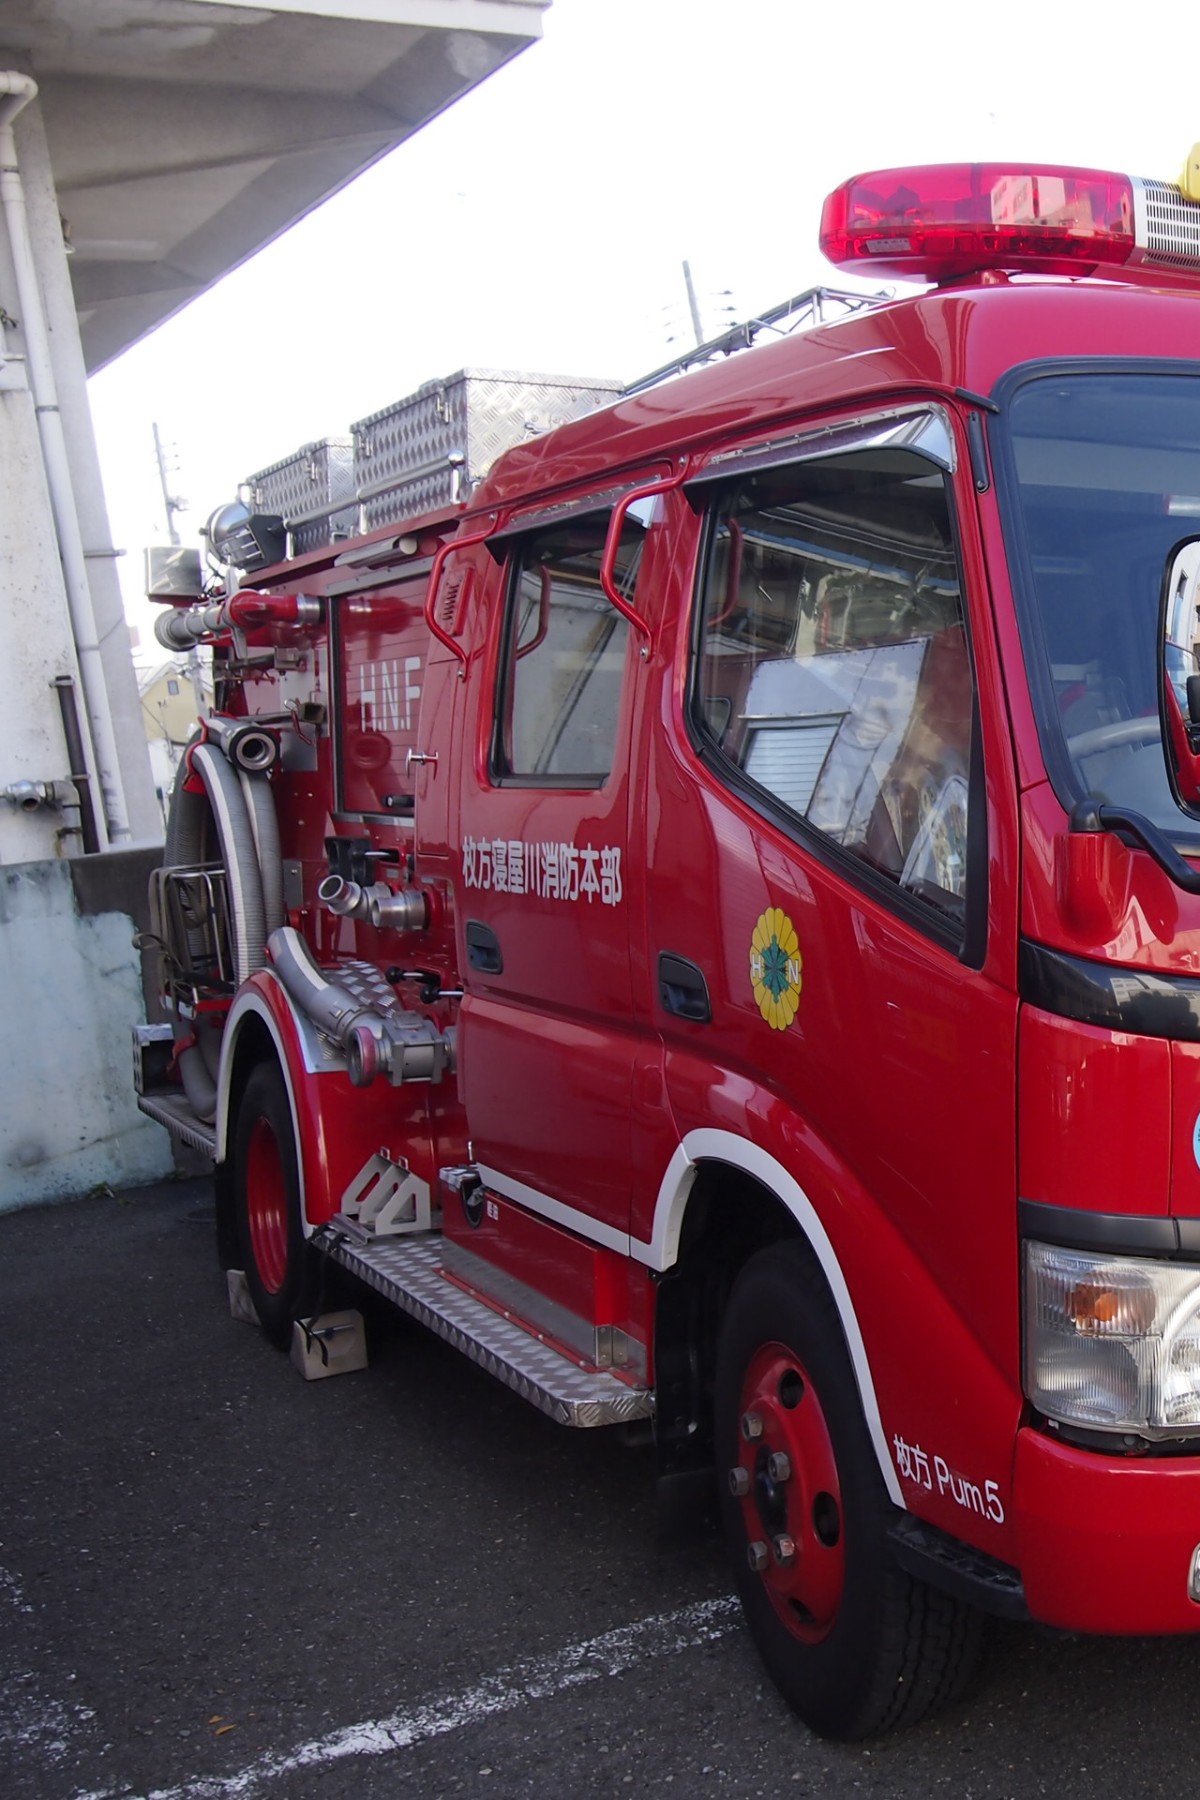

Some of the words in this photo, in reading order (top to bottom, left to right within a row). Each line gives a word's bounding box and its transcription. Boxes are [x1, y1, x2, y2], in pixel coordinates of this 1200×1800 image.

[462, 835, 623, 907] 枚方寝屋川消防本部
